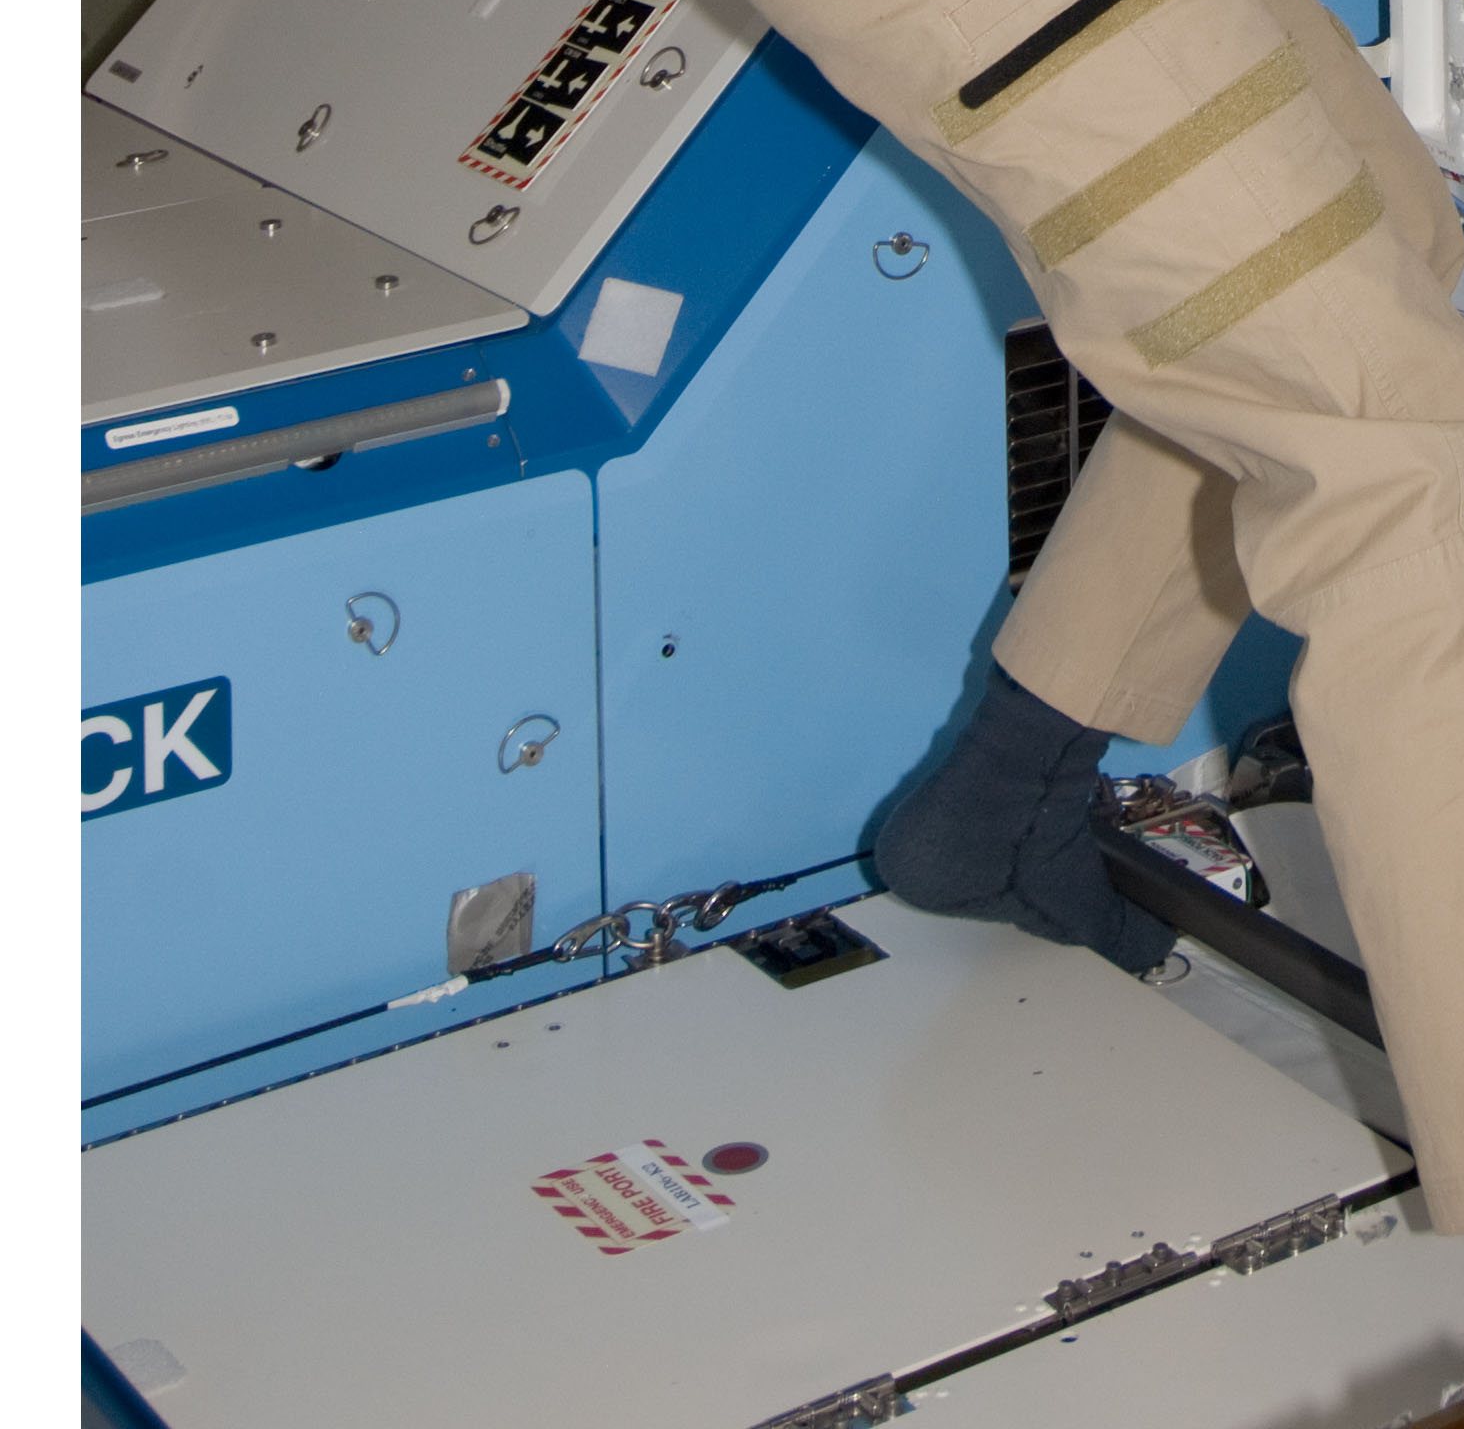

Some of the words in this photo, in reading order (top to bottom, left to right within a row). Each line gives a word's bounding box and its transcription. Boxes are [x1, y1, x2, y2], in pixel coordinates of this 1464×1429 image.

[82, 688, 225, 813] CK
[561, 1177, 585, 1196] USE
[594, 1166, 643, 1200] PORT
[631, 1196, 675, 1226] FIRE
